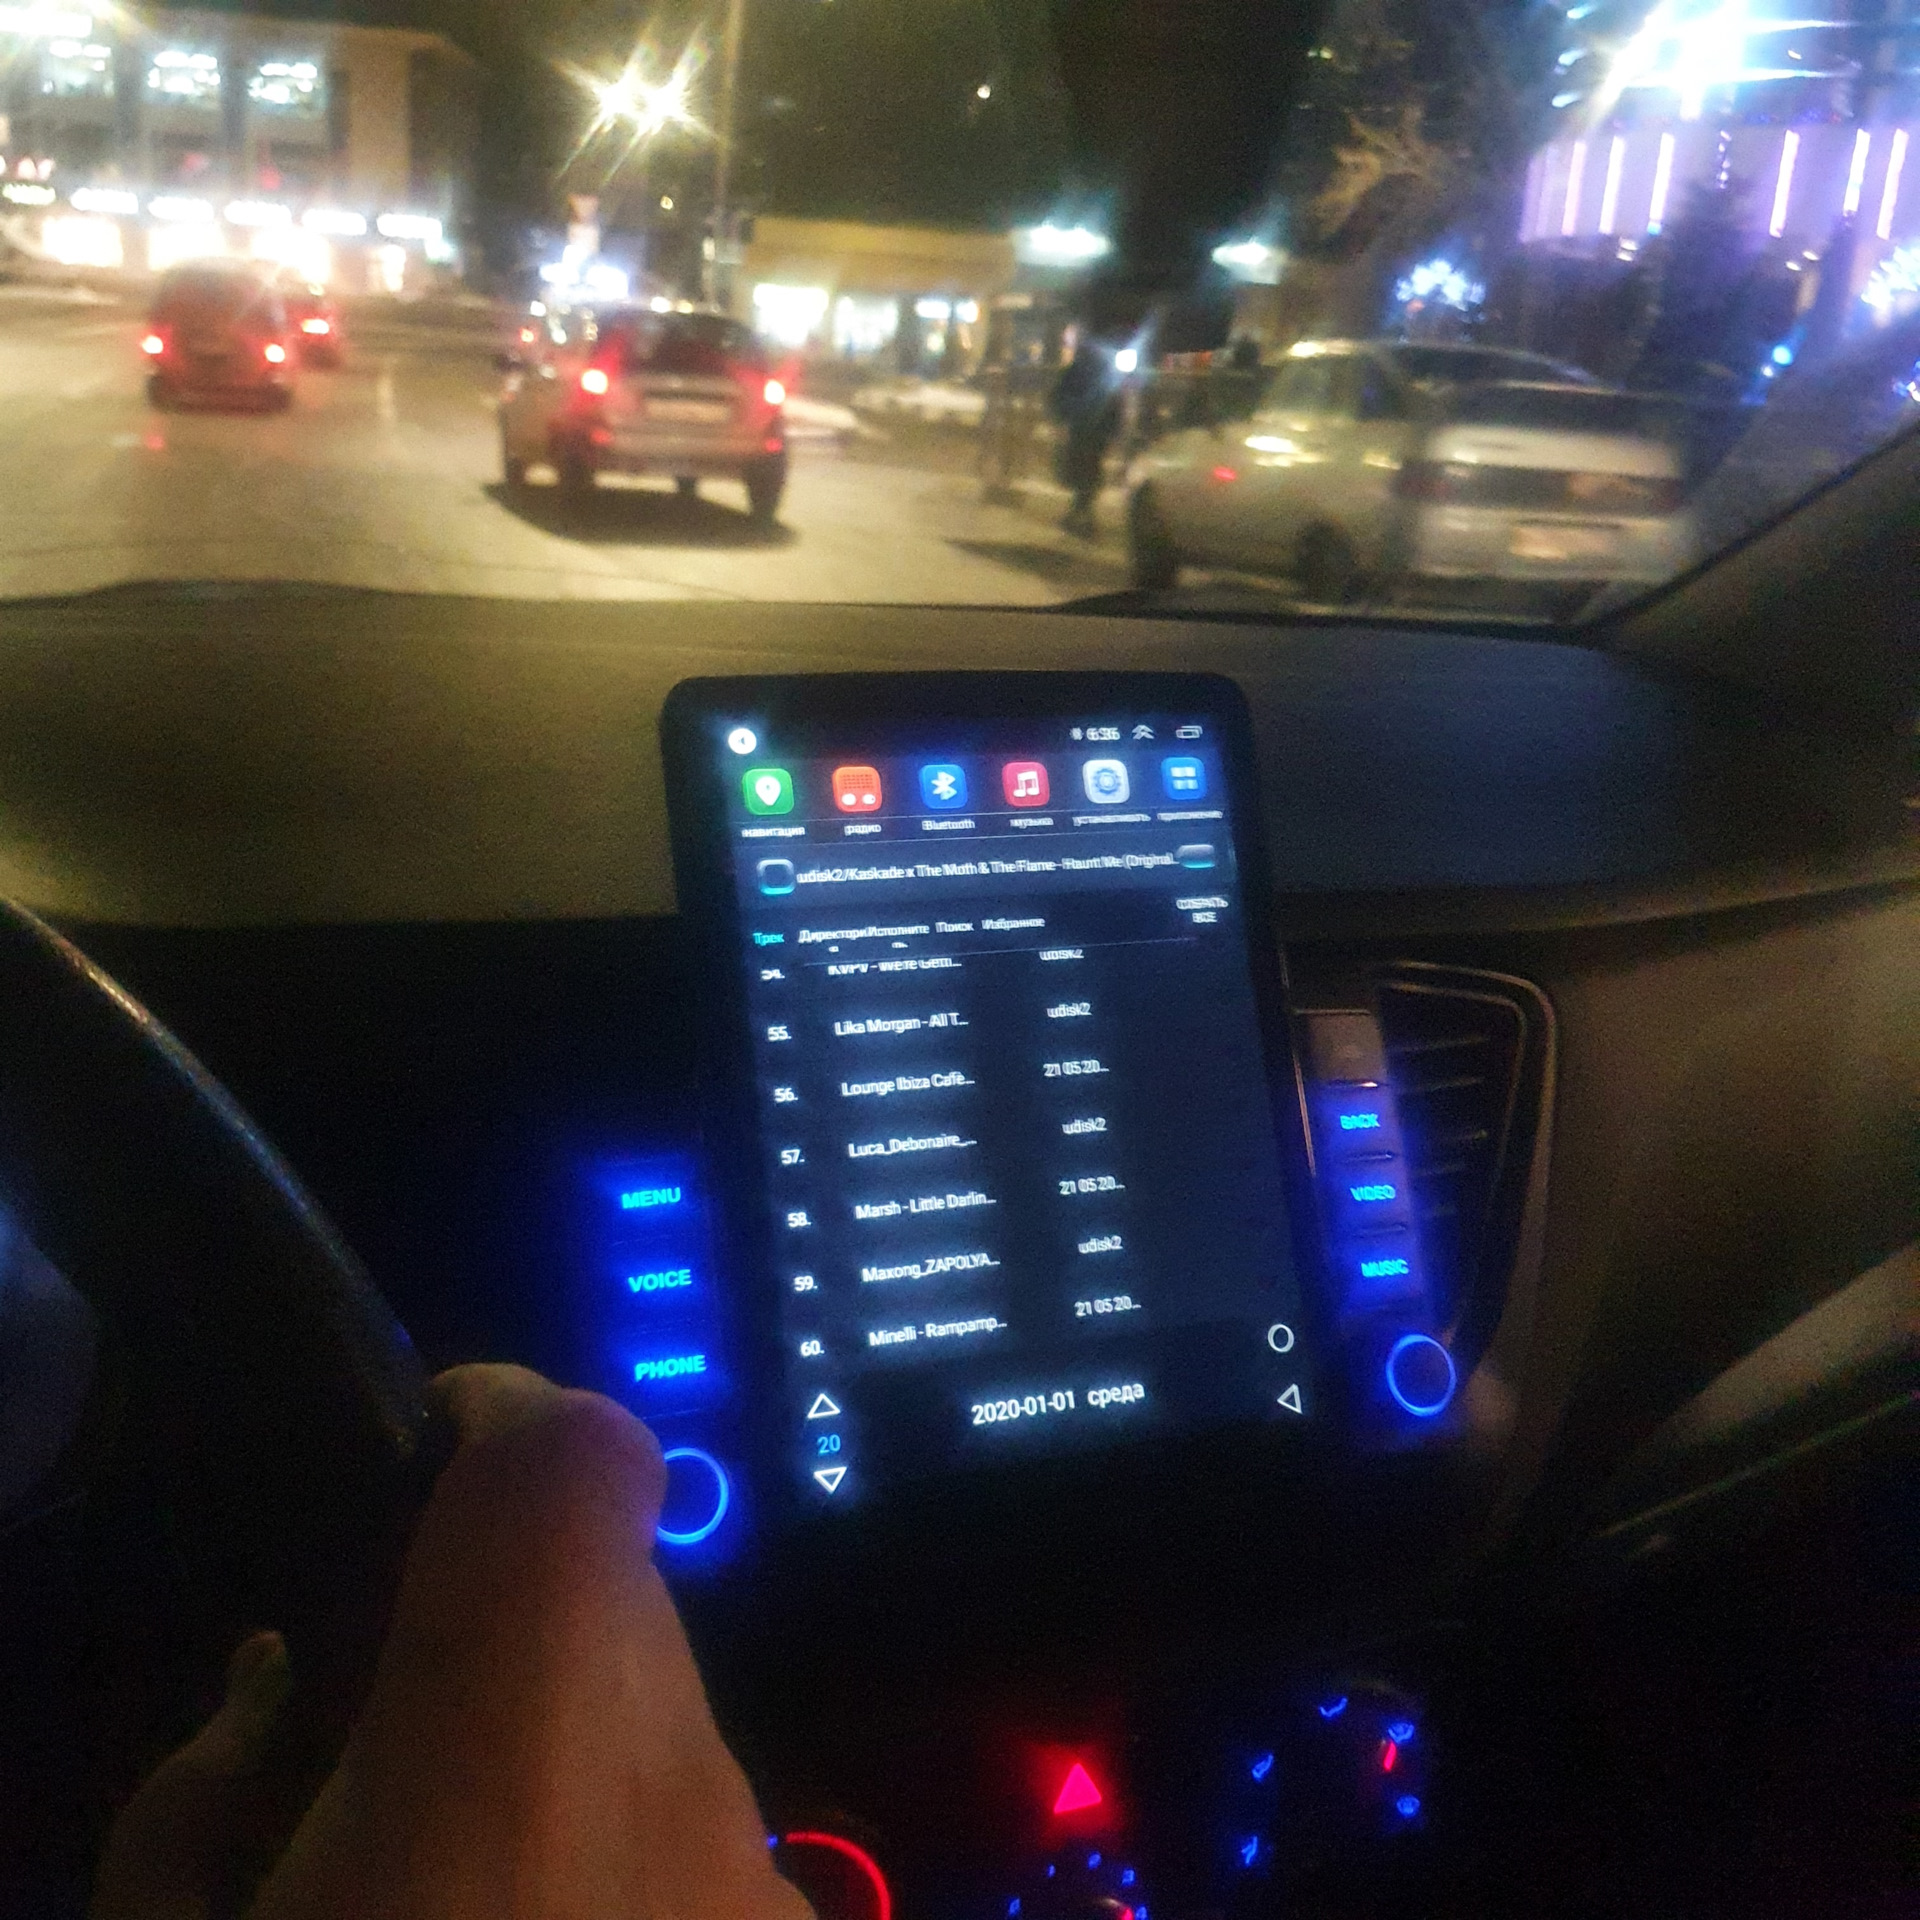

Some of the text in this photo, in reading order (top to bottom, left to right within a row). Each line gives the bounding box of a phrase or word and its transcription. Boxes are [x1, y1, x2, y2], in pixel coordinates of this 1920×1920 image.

[844, 824, 881, 836] радио
[922, 818, 975, 830] Bluetooth
[914, 864, 942, 877] The
[989, 860, 1016, 874] The
[935, 921, 974, 933] Поиск
[982, 917, 1045, 931] Избранное
[753, 932, 785, 946] Трек
[1047, 1002, 1092, 1018] udisk2
[834, 1021, 866, 1036] Lika
[866, 1018, 921, 1034] Morgan
[841, 1081, 895, 1097] Lounge
[896, 1076, 930, 1091] Ibiza
[774, 1088, 798, 1103] 56.
[1062, 1117, 1107, 1135] udisk2
[781, 1149, 805, 1165] 57.
[621, 1187, 681, 1209] MENU
[855, 1201, 902, 1220] Marsh
[909, 1196, 946, 1213] Little
[788, 1212, 812, 1228] 58.
[1078, 1235, 1123, 1254] udisk2
[1361, 1258, 1409, 1277] MUSIC
[628, 1269, 692, 1293] VOICE
[794, 1275, 818, 1292] 59.
[869, 1326, 917, 1347] Minelli
[801, 1340, 824, 1356] 60.
[634, 1354, 707, 1382] PHONE
[970, 1382, 1145, 1426] 2020-01-01 среда
[817, 1434, 841, 1455] 20
